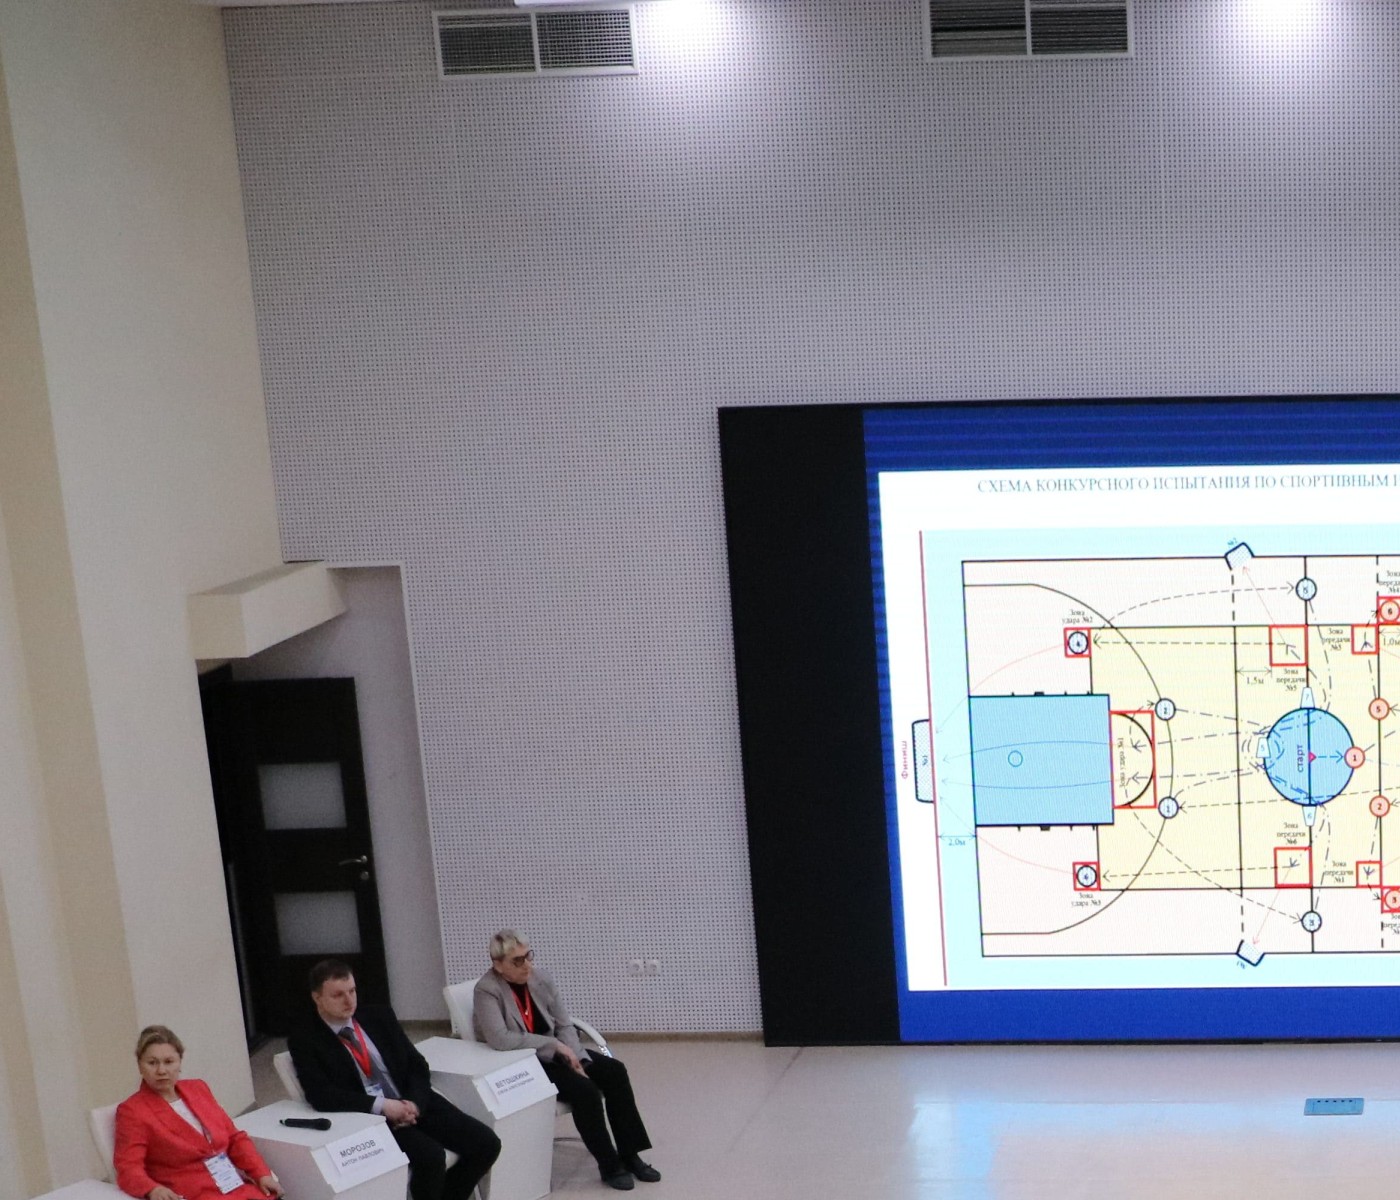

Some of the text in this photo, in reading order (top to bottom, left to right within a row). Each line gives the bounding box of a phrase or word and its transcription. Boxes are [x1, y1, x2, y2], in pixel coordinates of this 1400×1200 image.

[977, 479, 1032, 493] СХЕМА
[1036, 478, 1149, 492] КОНКУРСНОГО
[1153, 476, 1250, 490] ИСПЫТАНИЯ
[1254, 475, 1276, 488] ПО
[1279, 474, 1389, 488] СПОРТИВНЫМ
[1386, 570, 1400, 578] Зона
[1296, 744, 1304, 773] старт
[1283, 822, 1298, 830] Зона
[339, 1140, 376, 1158] МОРОЗОВ
